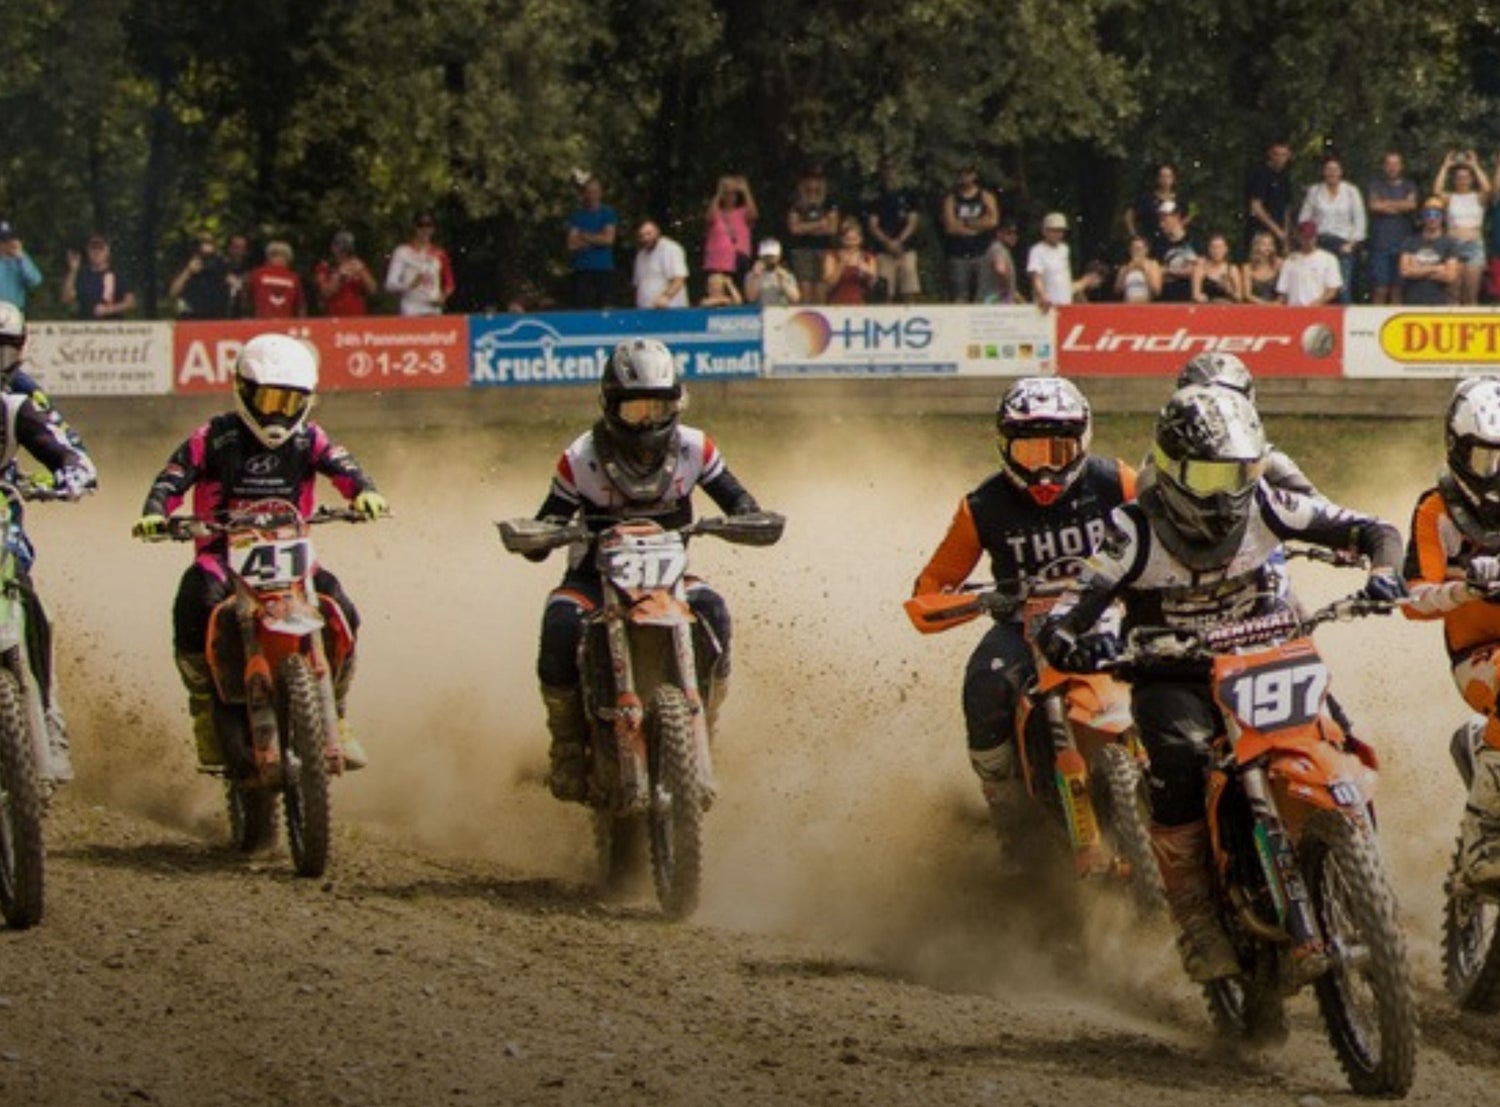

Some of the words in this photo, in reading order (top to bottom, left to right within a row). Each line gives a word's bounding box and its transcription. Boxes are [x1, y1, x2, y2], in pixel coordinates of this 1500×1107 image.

[840, 317, 934, 350] HMS
[1062, 323, 1291, 353] Lindner
[1006, 517, 1106, 563] THOR
[241, 541, 308, 580] 41
[607, 550, 687, 589] 317
[1231, 663, 1328, 729] 197
